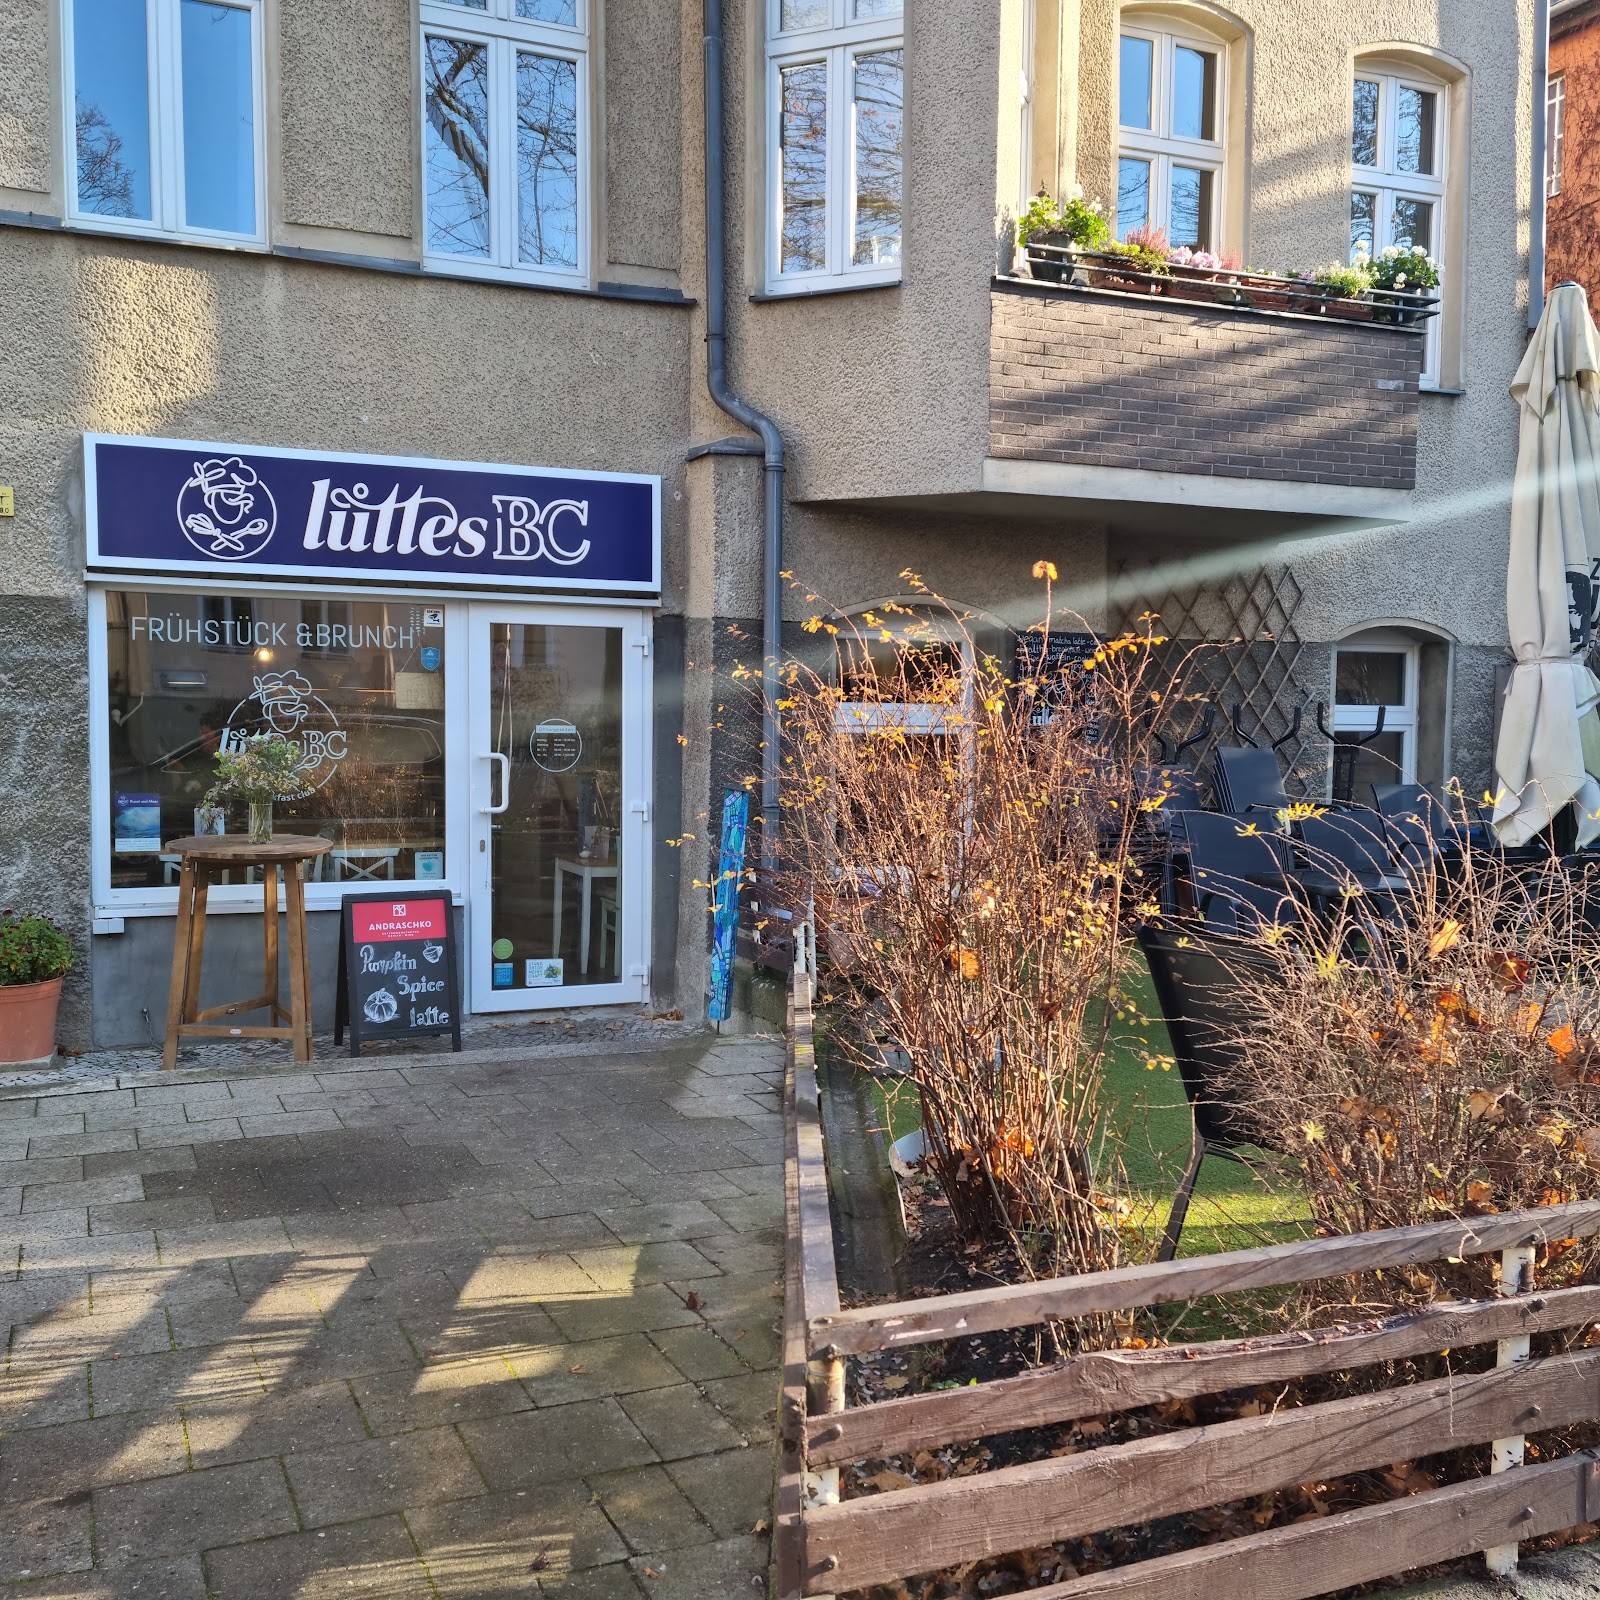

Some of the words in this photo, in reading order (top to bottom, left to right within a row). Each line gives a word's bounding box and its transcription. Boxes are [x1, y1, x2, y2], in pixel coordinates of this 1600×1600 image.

[491, 494, 591, 566] BC
[131, 612, 287, 646] FRÜHSTÜCK
[368, 920, 432, 931] ANDRASCHKO
[360, 944, 417, 975] Pumpkin
[397, 975, 445, 1002] Spice
[409, 1006, 450, 1027] latte
